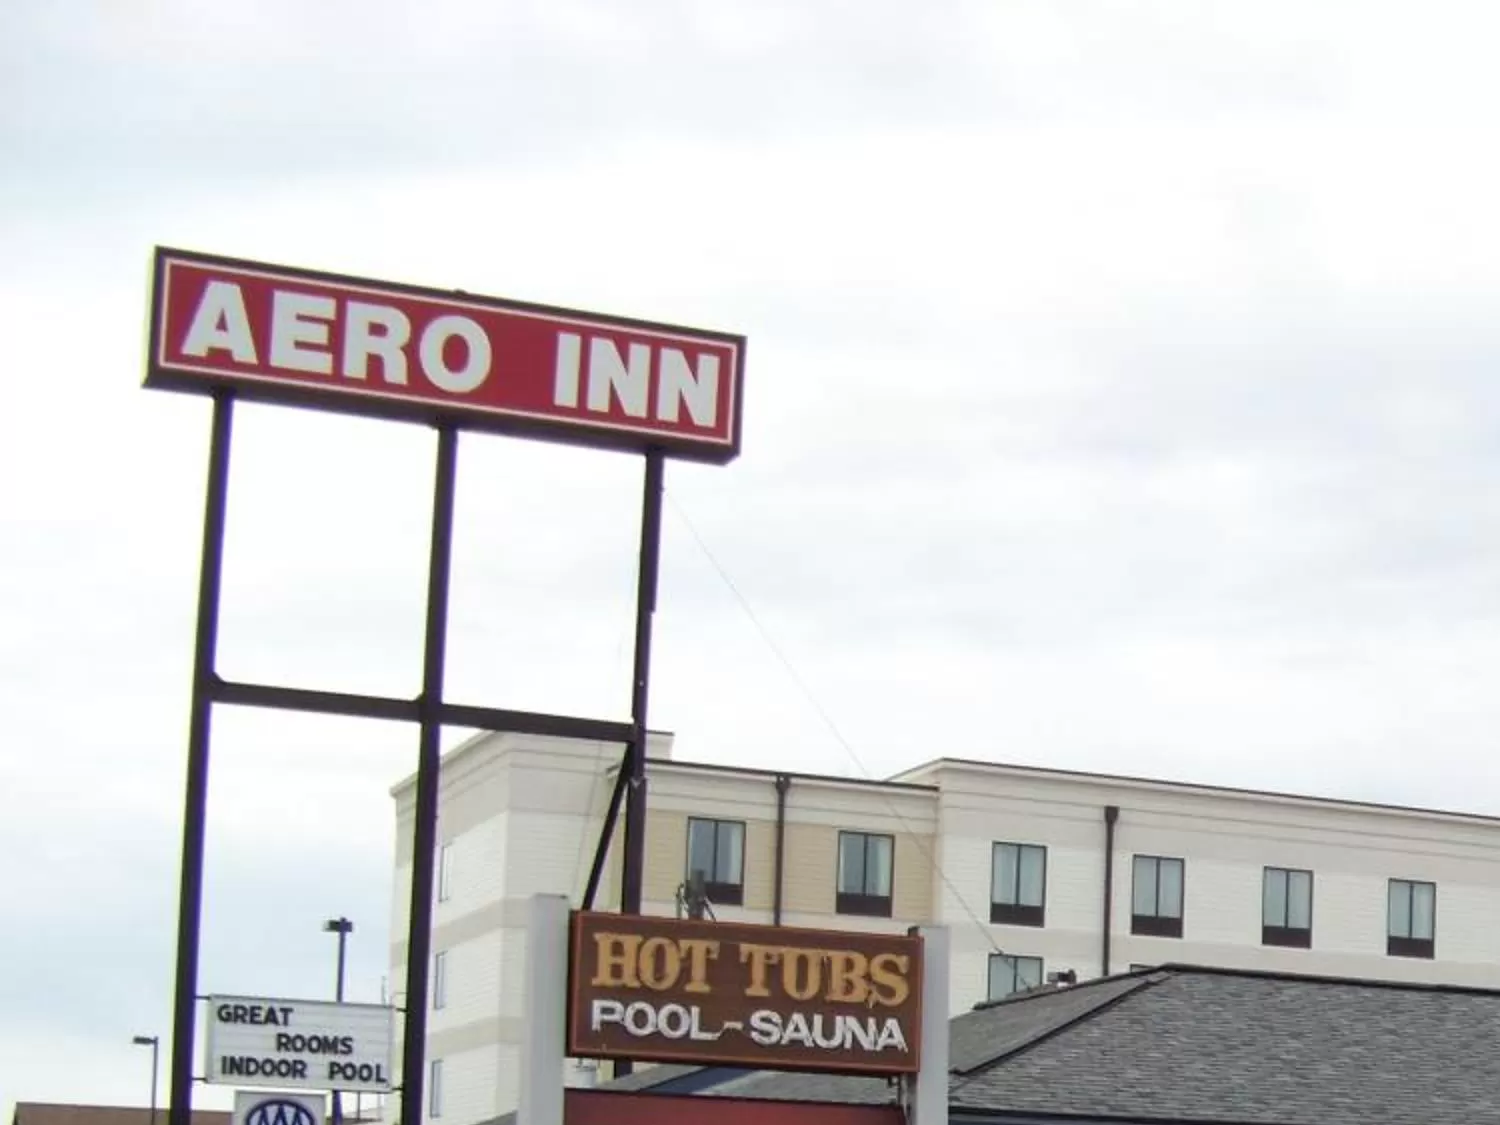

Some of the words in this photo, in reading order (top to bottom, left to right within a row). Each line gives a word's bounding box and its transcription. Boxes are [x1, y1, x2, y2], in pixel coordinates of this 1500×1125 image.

[180, 279, 493, 394] AERO
[552, 330, 721, 428] INN
[591, 931, 721, 994] HOT
[740, 944, 911, 1008] TUBS
[216, 1003, 294, 1027] GREAT
[275, 1032, 354, 1055] ROOMS
[220, 1055, 307, 1079] INDOOR
[327, 1061, 388, 1084] POOL
